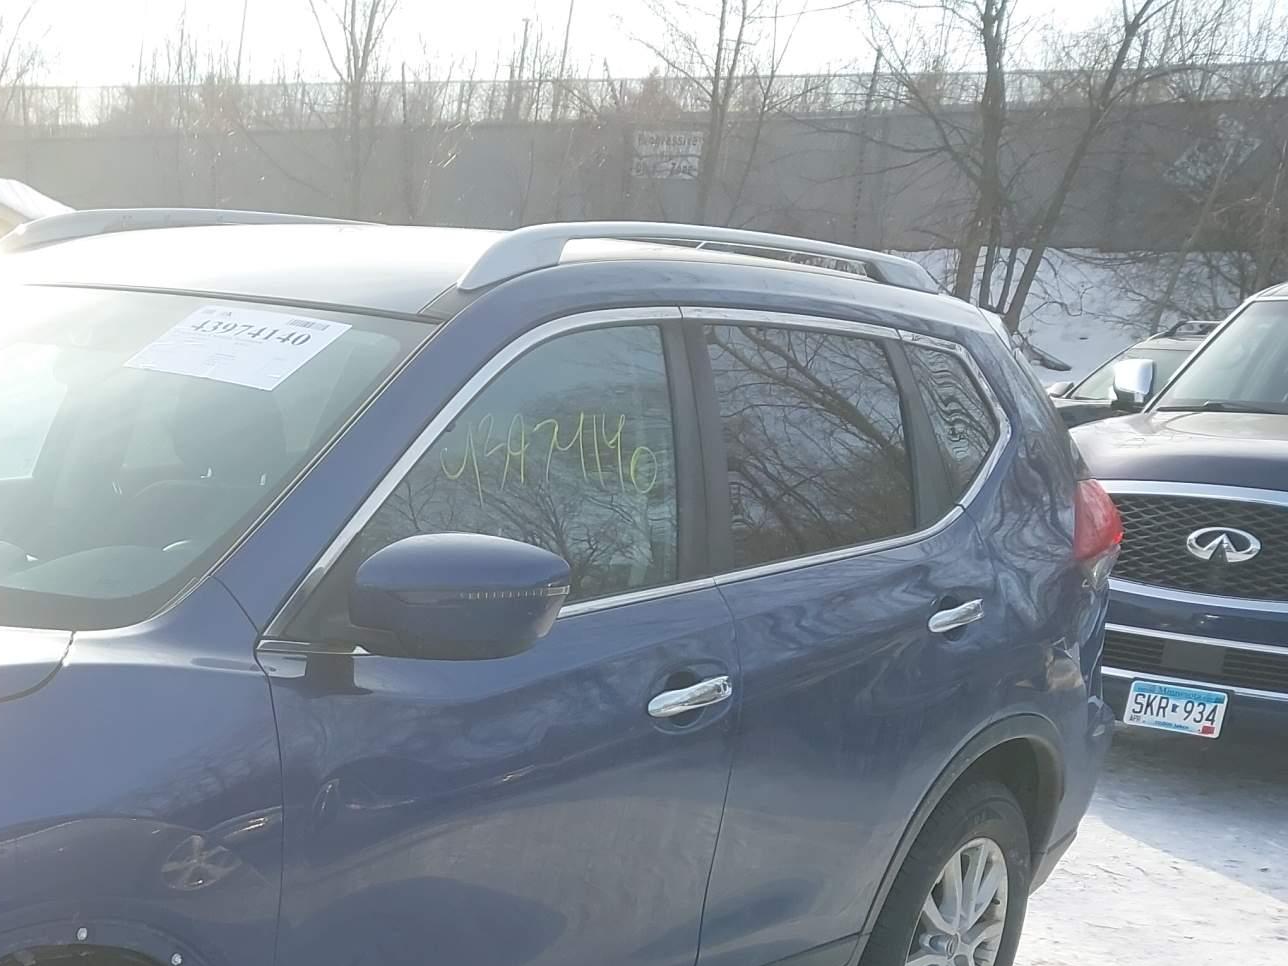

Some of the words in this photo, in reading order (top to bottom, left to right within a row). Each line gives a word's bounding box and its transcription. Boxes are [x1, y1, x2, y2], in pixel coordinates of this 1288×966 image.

[191, 319, 313, 347] 43974140
[1132, 693, 1169, 719] SKR
[1183, 700, 1219, 726] 934
